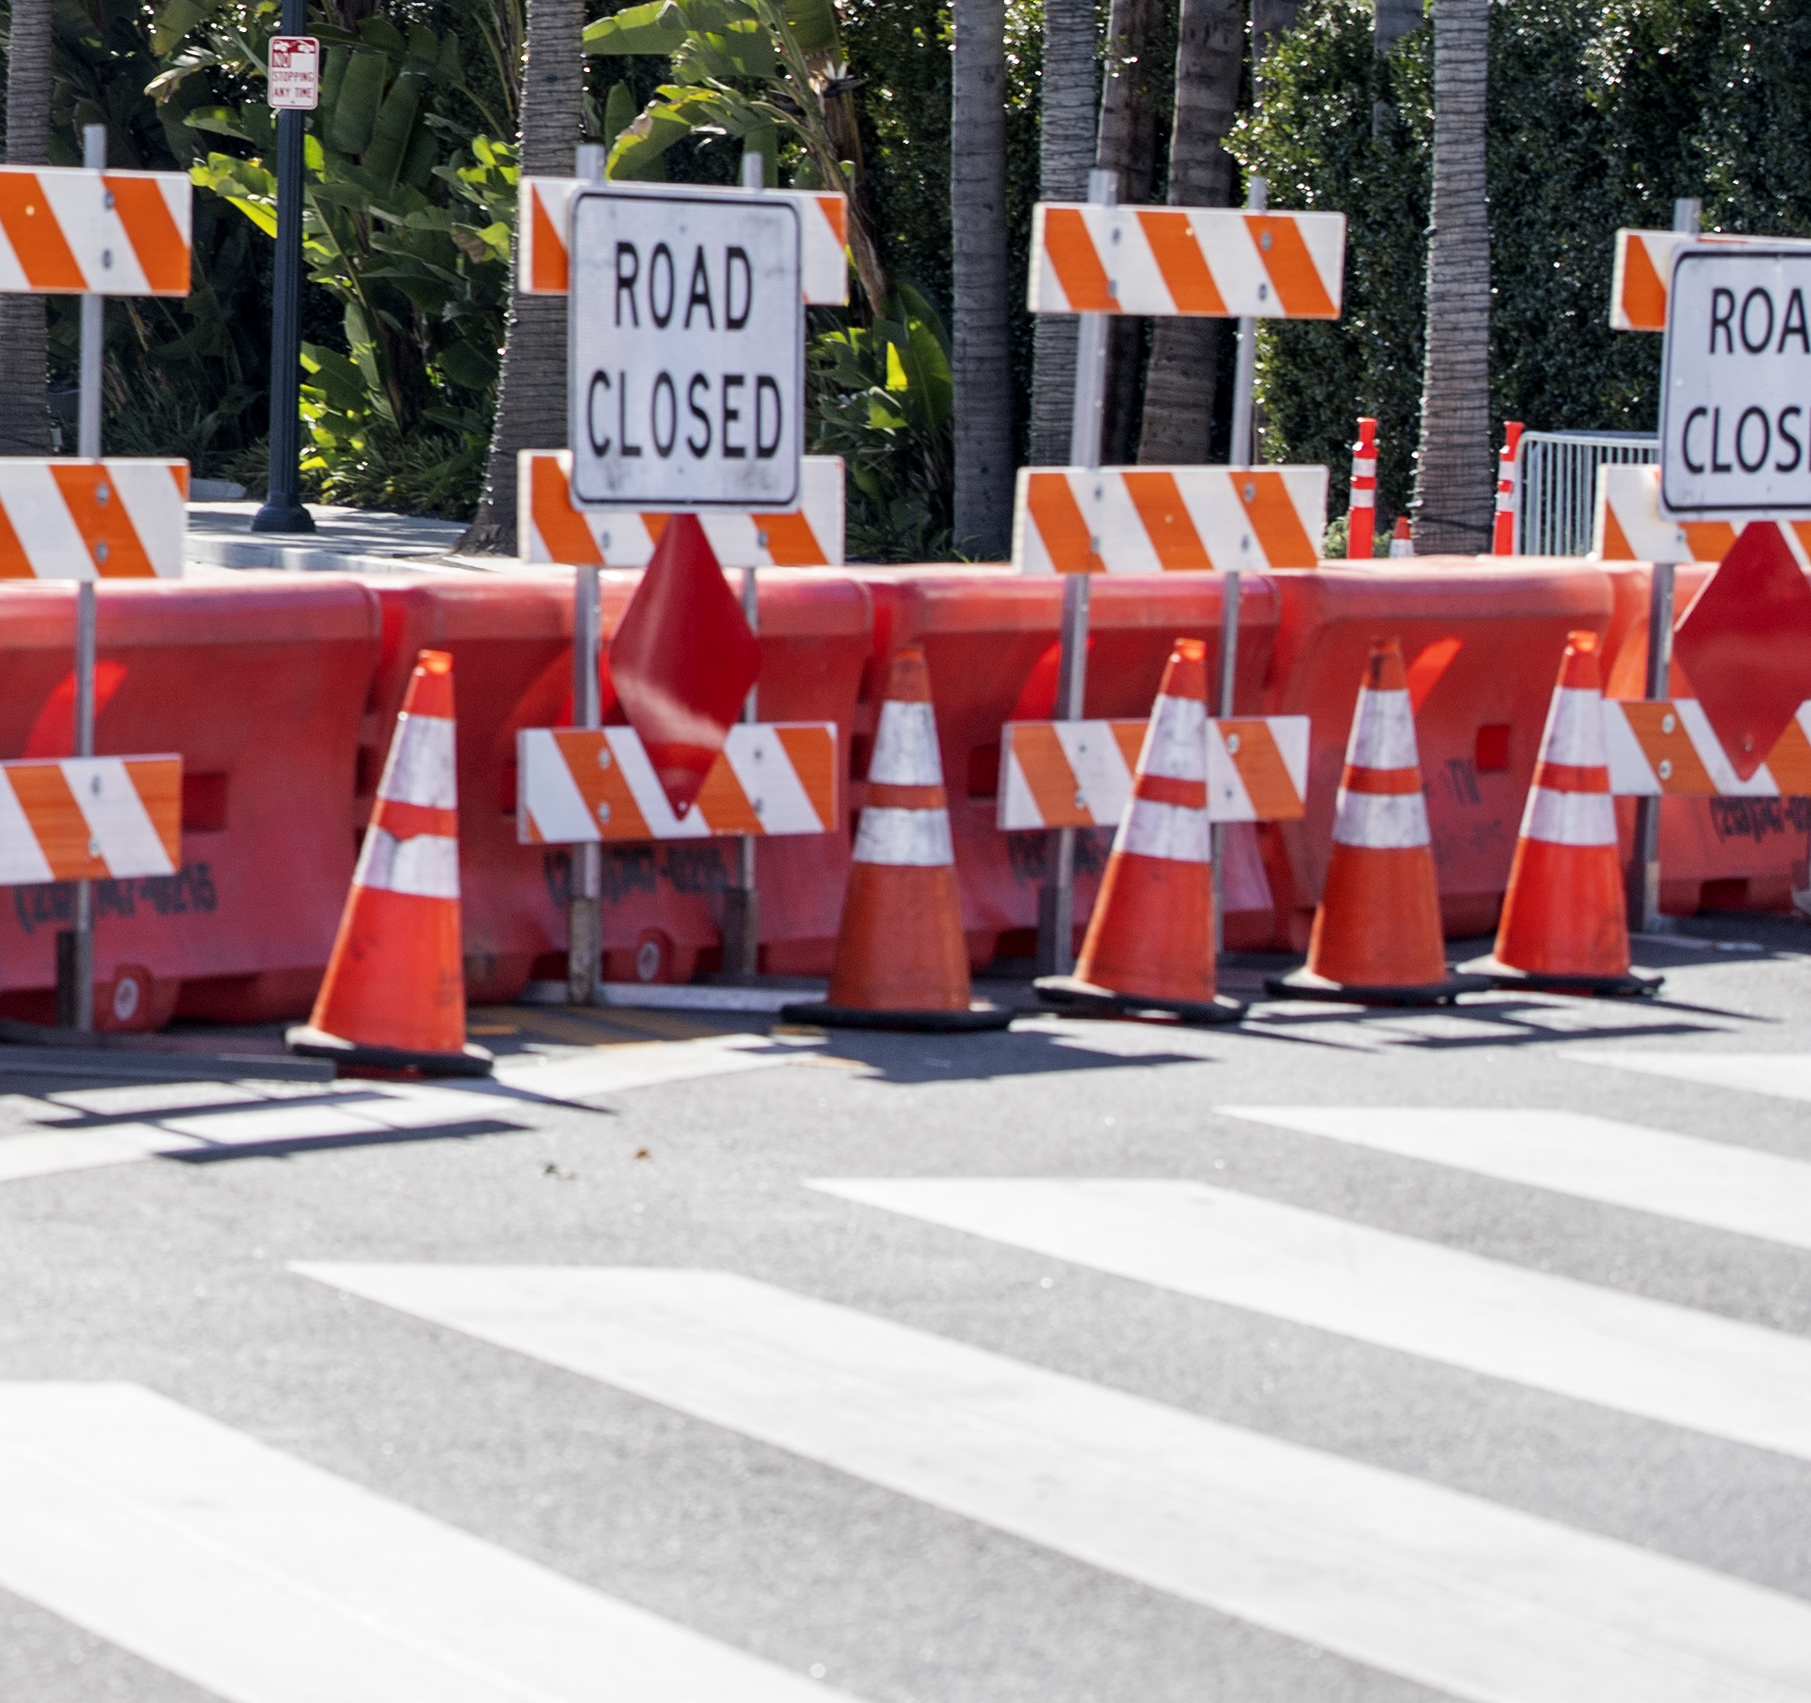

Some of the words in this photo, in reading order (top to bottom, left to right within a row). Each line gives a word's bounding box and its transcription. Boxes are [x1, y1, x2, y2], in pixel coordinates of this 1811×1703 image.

[272, 71, 315, 82] STOPPING
[614, 241, 752, 331] ROAD
[1710, 287, 1811, 354] ROA
[587, 370, 783, 459] CLOSED
[1682, 406, 1811, 474] CLOS
